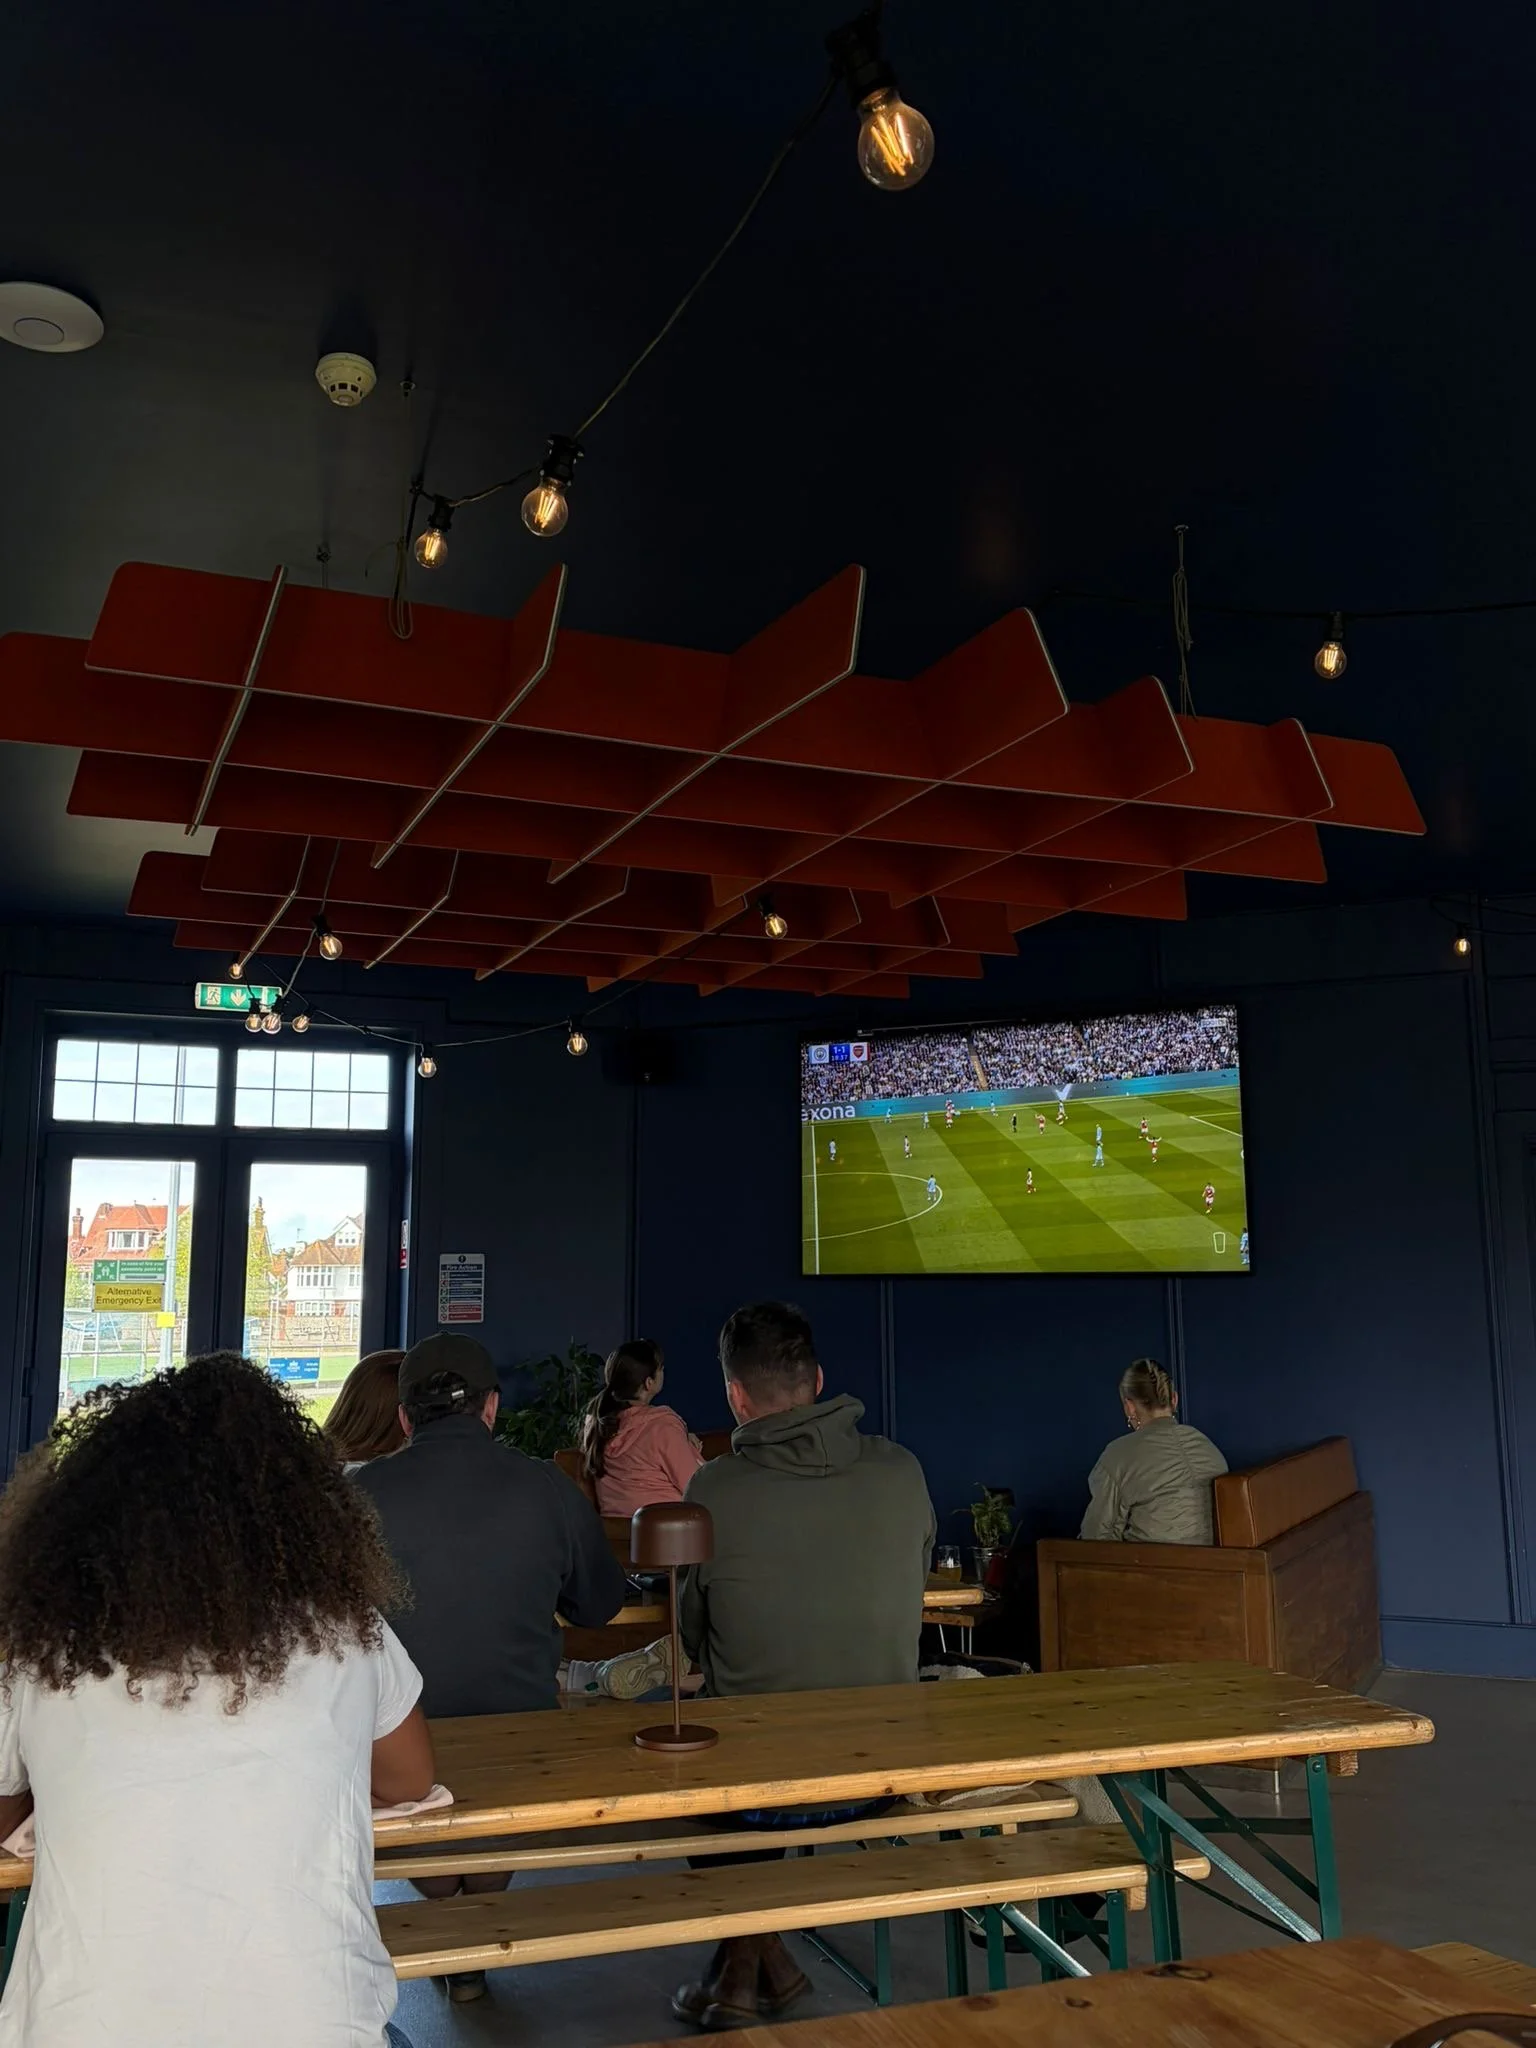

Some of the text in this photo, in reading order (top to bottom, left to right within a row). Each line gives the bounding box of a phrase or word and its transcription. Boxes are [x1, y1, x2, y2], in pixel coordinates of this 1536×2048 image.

[833, 1046, 846, 1054] 1-1
[107, 1287, 152, 1296] Alternative
[96, 1296, 162, 1306] Emergency Exit
